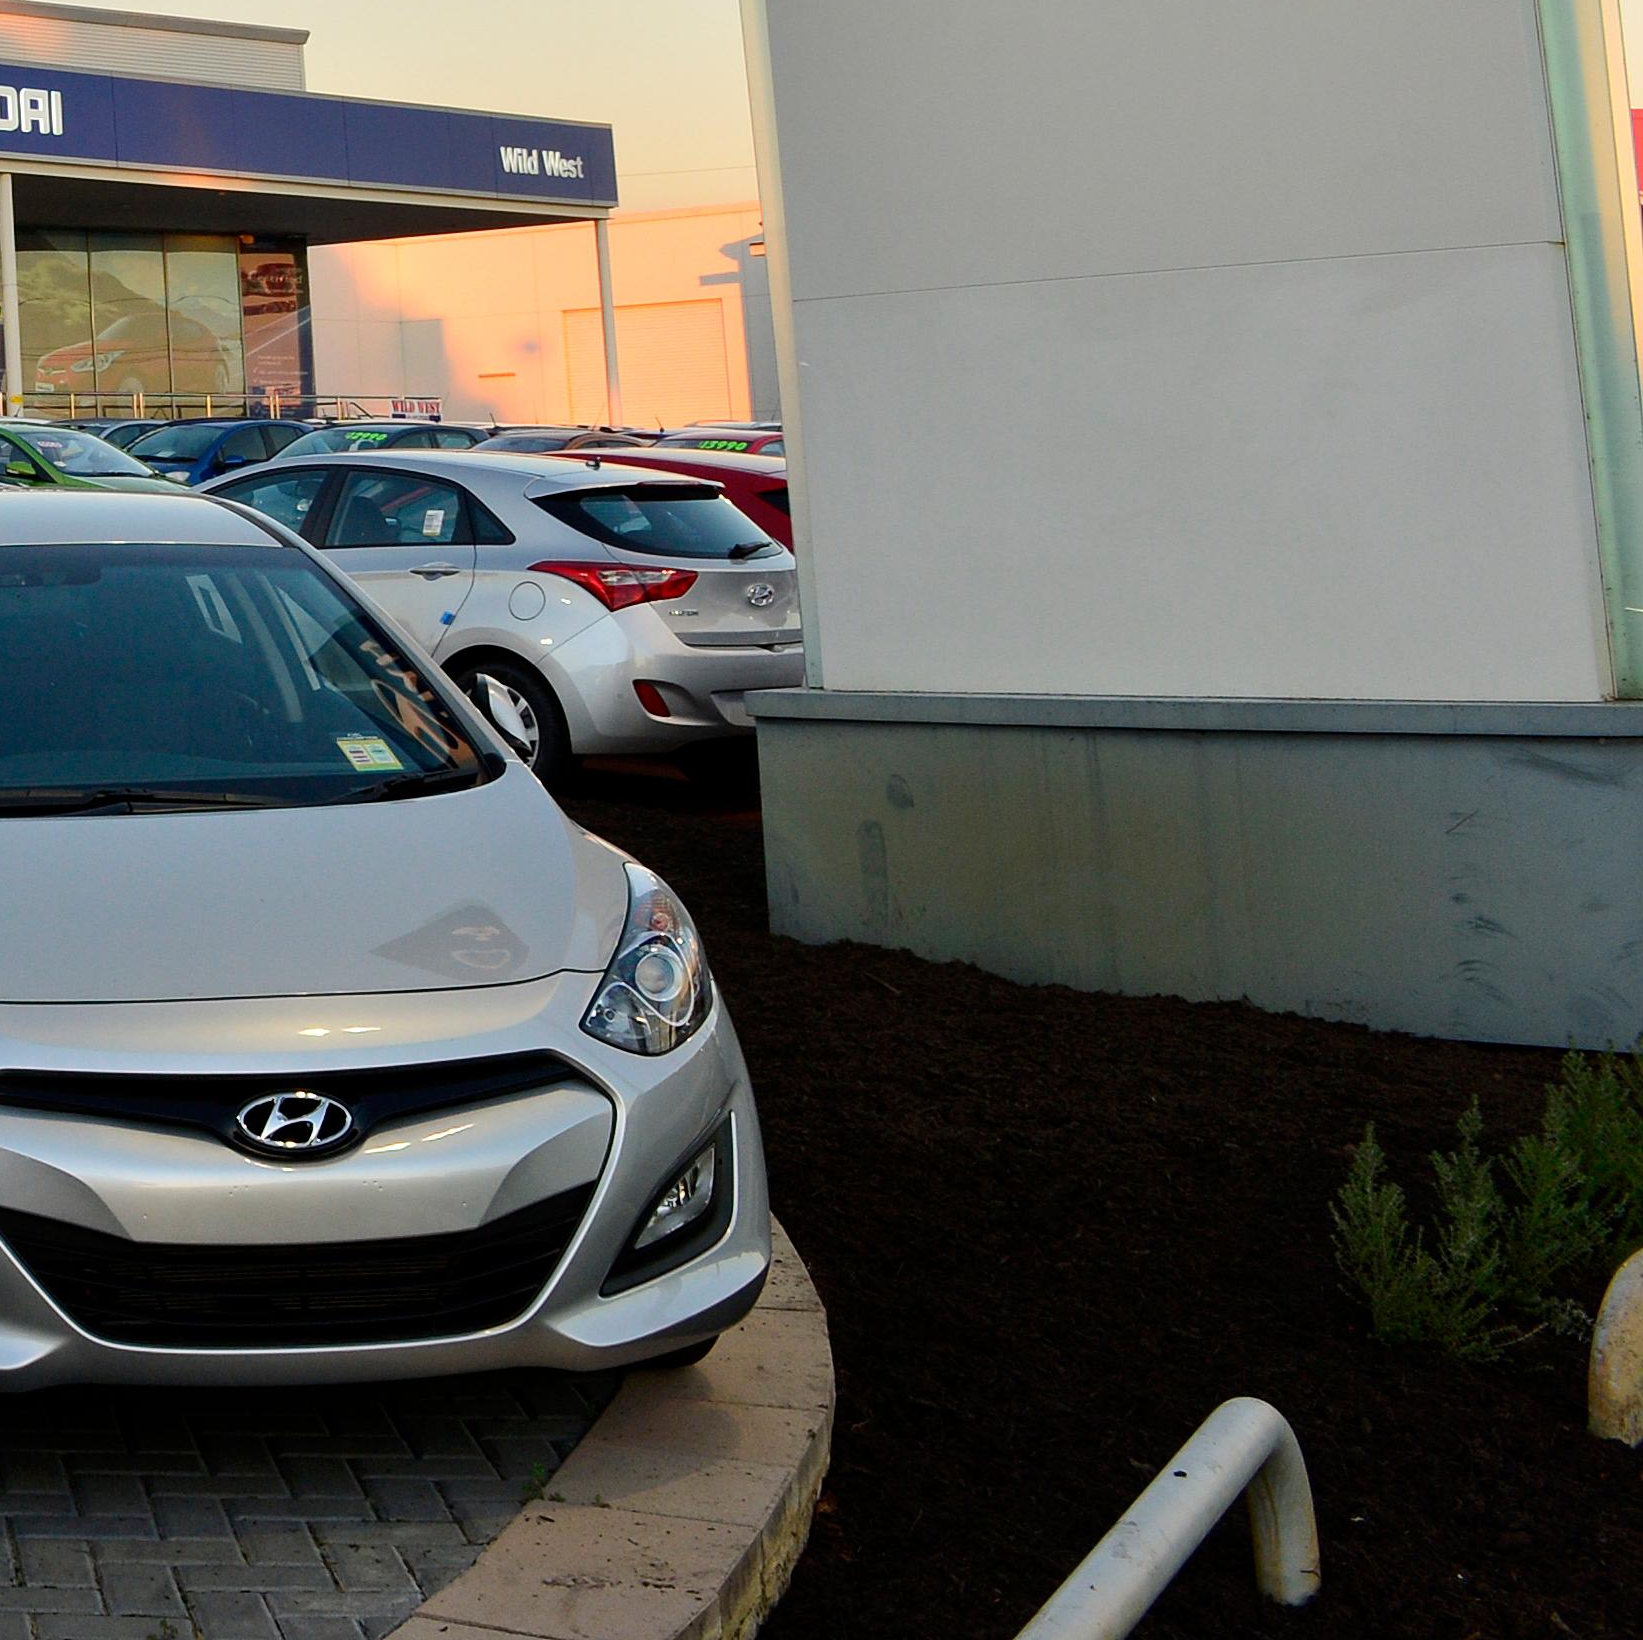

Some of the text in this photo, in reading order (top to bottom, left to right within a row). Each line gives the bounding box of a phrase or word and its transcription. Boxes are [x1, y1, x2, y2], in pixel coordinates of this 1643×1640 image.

[499, 145, 584, 180] Wild West
[391, 400, 441, 414] WILD WEST
